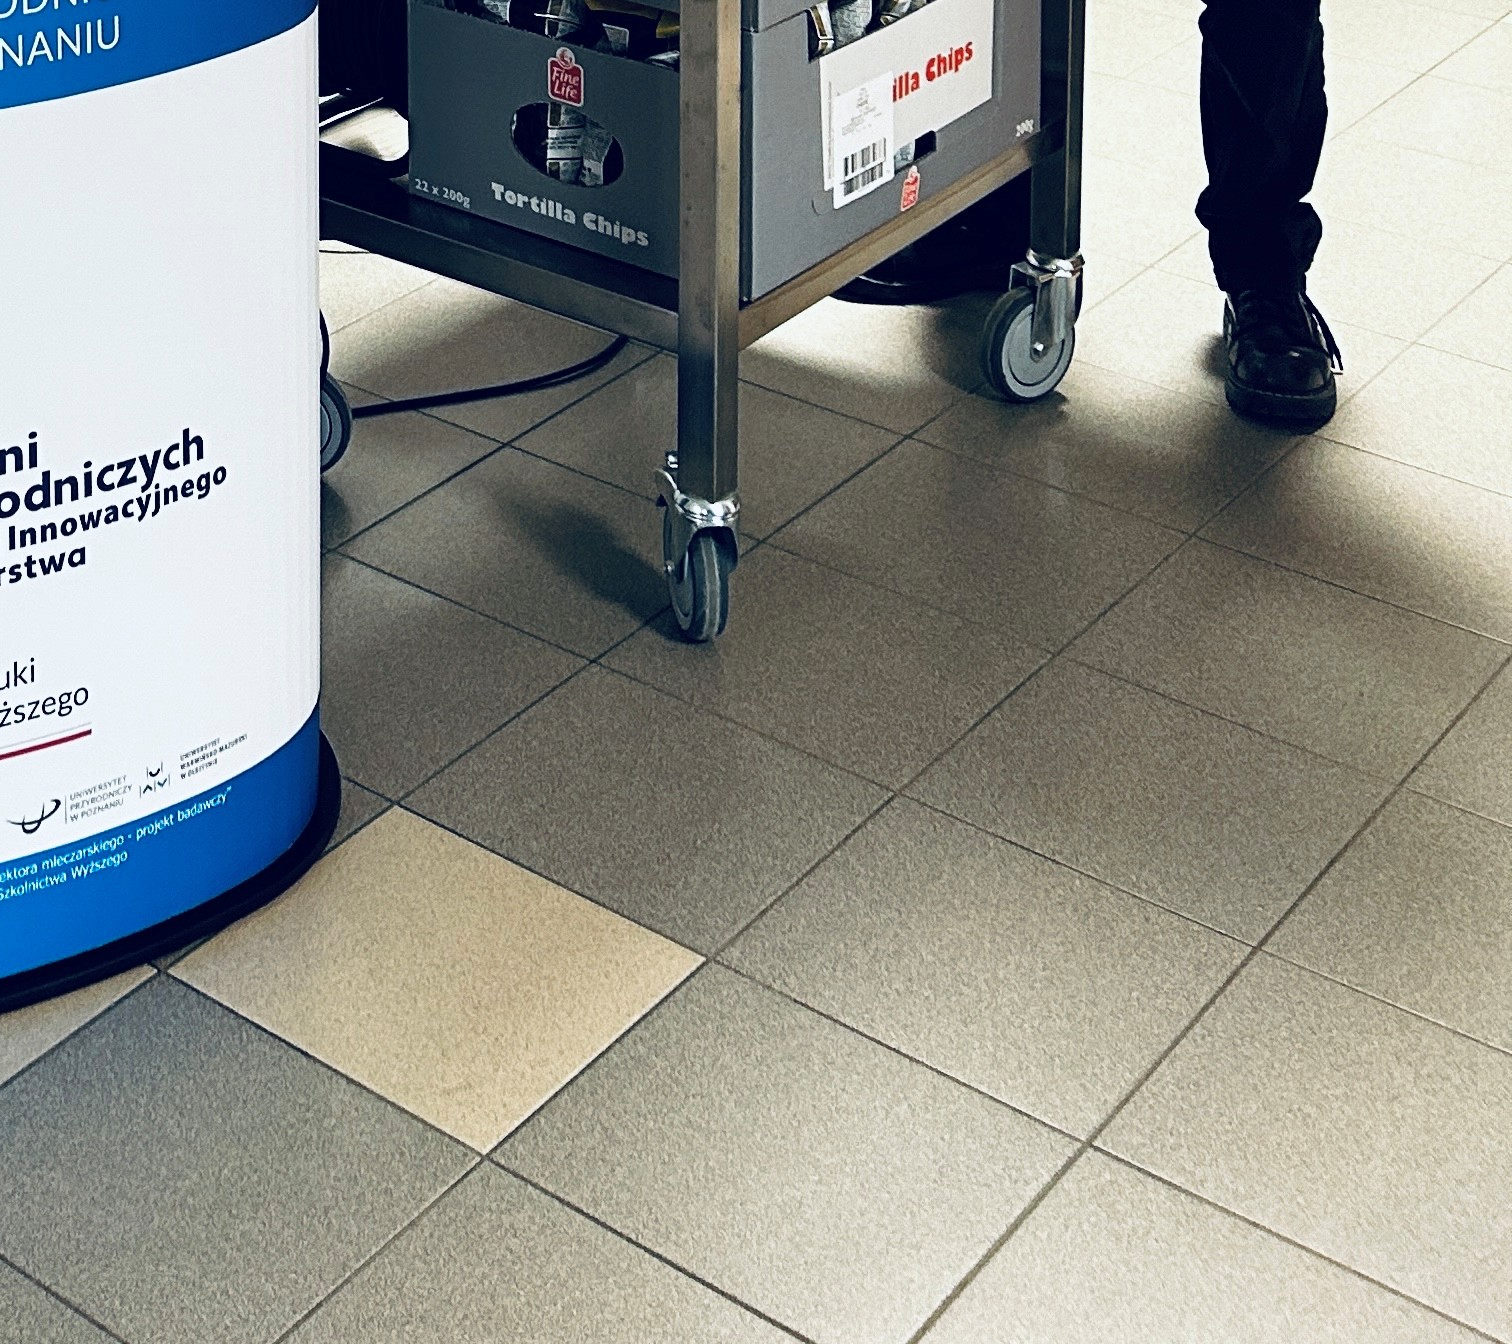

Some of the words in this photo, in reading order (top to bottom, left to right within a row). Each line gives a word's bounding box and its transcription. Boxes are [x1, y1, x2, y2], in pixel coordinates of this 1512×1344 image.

[551, 66, 580, 86] Fine
[553, 78, 579, 99] Life
[892, 70, 921, 103] illa
[925, 40, 974, 83] Chips
[414, 178, 430, 193] 22
[442, 186, 472, 209] 200g
[490, 181, 577, 225] Tortilla
[582, 211, 650, 247] Chips
[7, 465, 228, 553] Innowacyjnego
[41, 834, 126, 872] mleczarskiego
[135, 815, 175, 842] projekt
[70, 849, 129, 880] Wyższego
